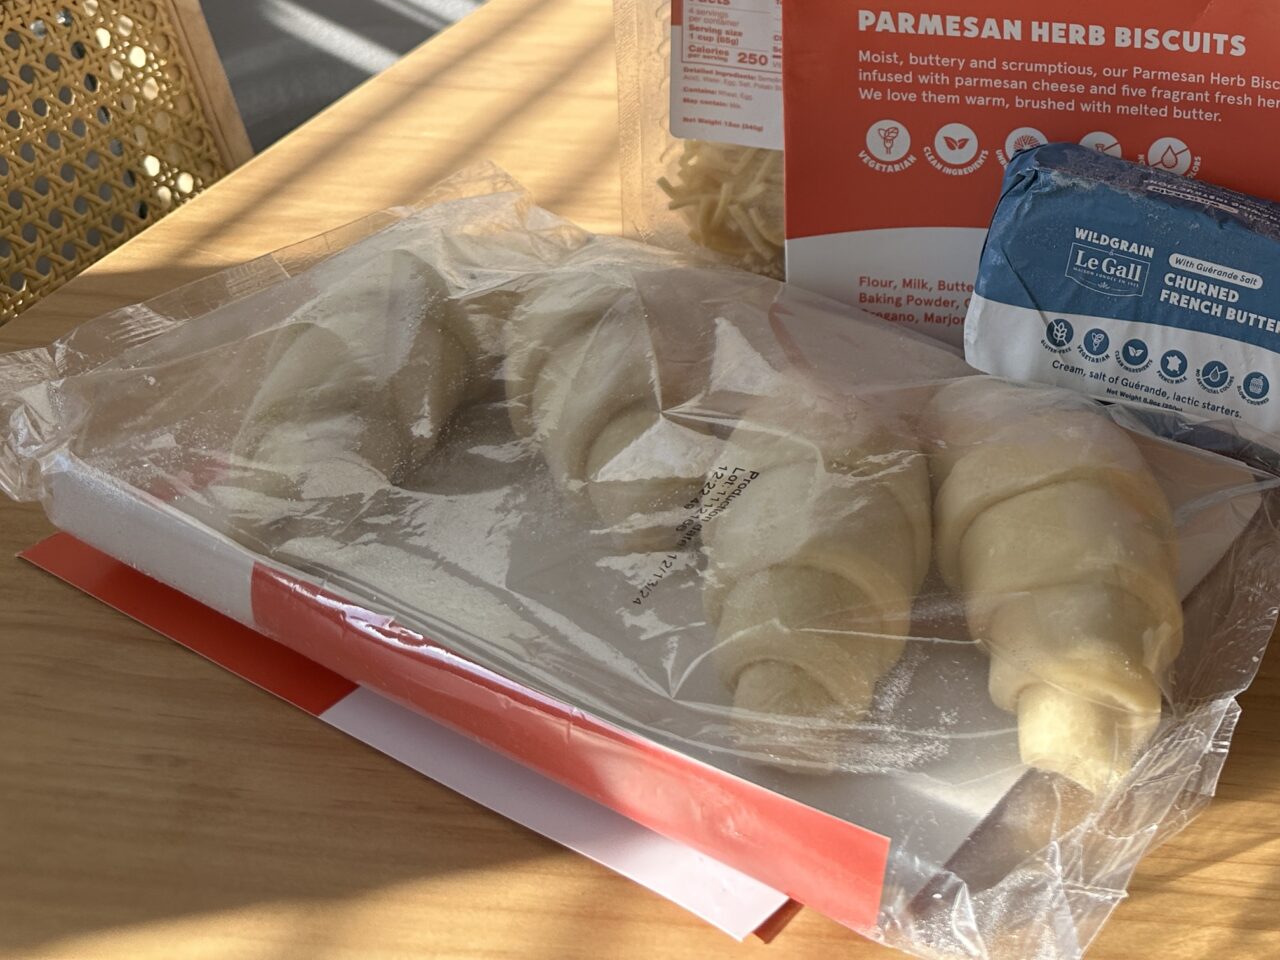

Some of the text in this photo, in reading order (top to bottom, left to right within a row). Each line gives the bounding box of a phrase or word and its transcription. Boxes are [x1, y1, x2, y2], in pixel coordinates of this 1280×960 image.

[688, 24, 722, 36] Serving
[858, 9, 1247, 57] PARMESAN HERB BISCUITS
[688, 45, 730, 56] Calories
[737, 52, 769, 66] 250
[858, 49, 904, 66] Moist,
[909, 52, 966, 71] buttery
[969, 57, 997, 70] and
[1001, 60, 1097, 78] scrumptious,
[1102, 67, 1129, 78] our
[1132, 66, 1205, 84] Parmesan
[1210, 71, 1247, 87] Herb
[858, 68, 913, 84] infused
[917, 71, 950, 85] with
[954, 76, 1028, 90] parmesan
[1031, 78, 1086, 94] cheese
[1089, 83, 1117, 96] and
[1121, 84, 1147, 98] five
[1151, 85, 1211, 103] fragrant
[1214, 90, 1253, 107] fresh
[858, 87, 1222, 122] We love them warm, brushed with melted butter.
[858, 150, 917, 173] VEGETARIAN
[923, 146, 943, 170] CLEAN
[942, 150, 989, 176] INGREDIENTS
[1075, 226, 1155, 259] WILDGRAIN
[858, 276, 974, 292] Flour, Milk, Butte
[1174, 256, 1258, 286] With Guérande Salt
[858, 292, 960, 310] Baking Powder,
[1164, 272, 1240, 303] CHURNED
[1159, 288, 1222, 318] FRENCH
[1077, 344, 1110, 363] VEGETARIAN
[1052, 359, 1087, 377] Cream,
[1089, 371, 1107, 383] salt
[1108, 375, 1120, 385] of
[1120, 377, 1171, 400] Guérande,
[1172, 391, 1200, 407] lactic
[1201, 401, 1242, 419] starters.
[701, 470, 759, 523] Production
